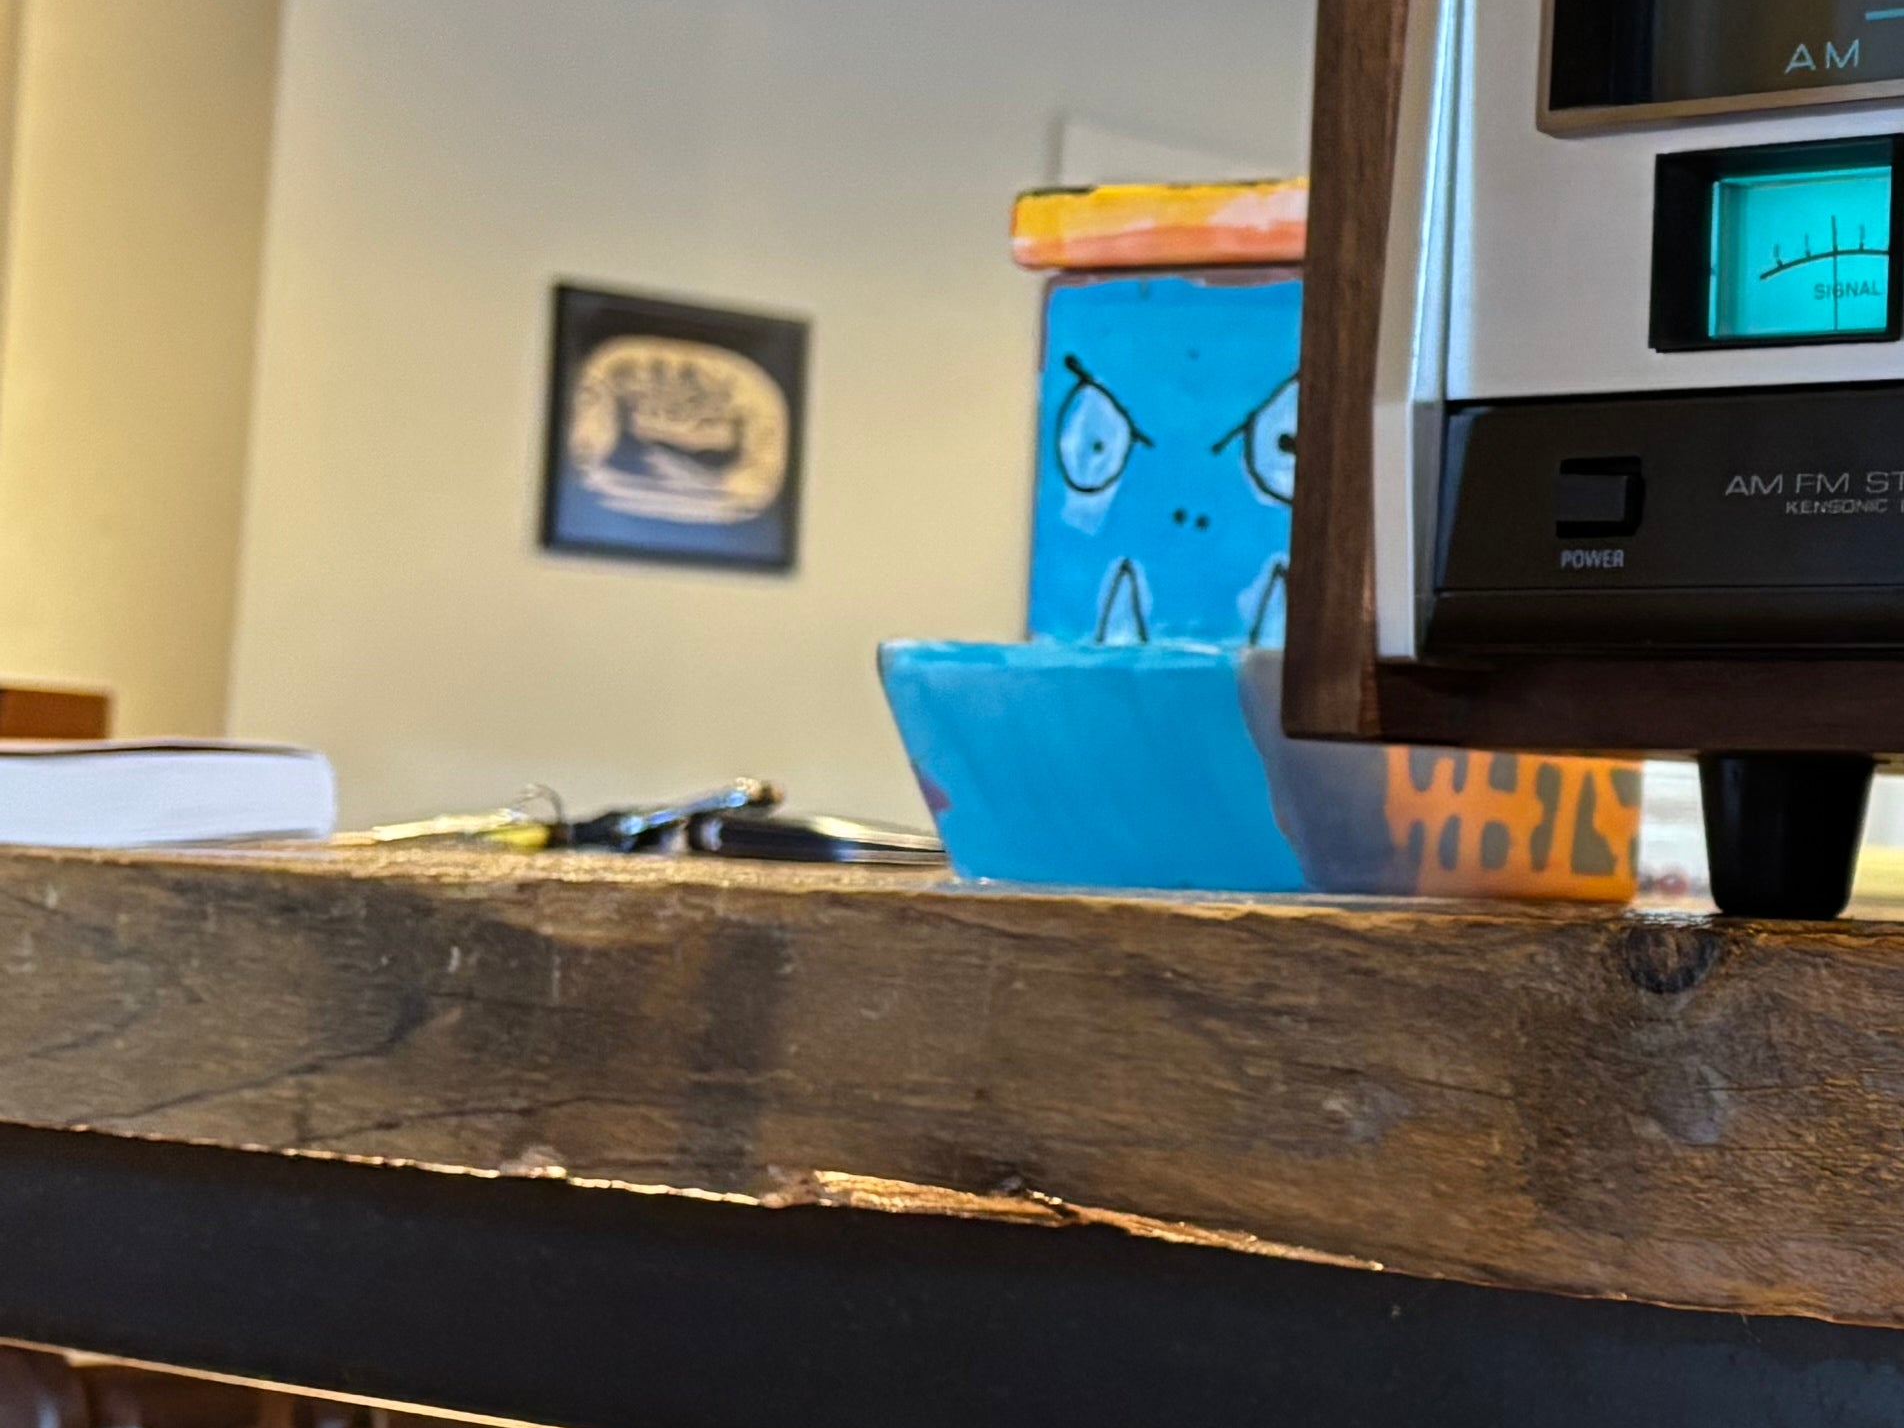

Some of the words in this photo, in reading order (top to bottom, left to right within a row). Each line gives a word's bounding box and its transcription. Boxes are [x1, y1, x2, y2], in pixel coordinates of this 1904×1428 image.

[1784, 38, 1860, 75] AM
[1813, 280, 1883, 301] SIGNAL
[1785, 498, 1889, 515] KENSONIC
[1560, 549, 1625, 570] POWER
